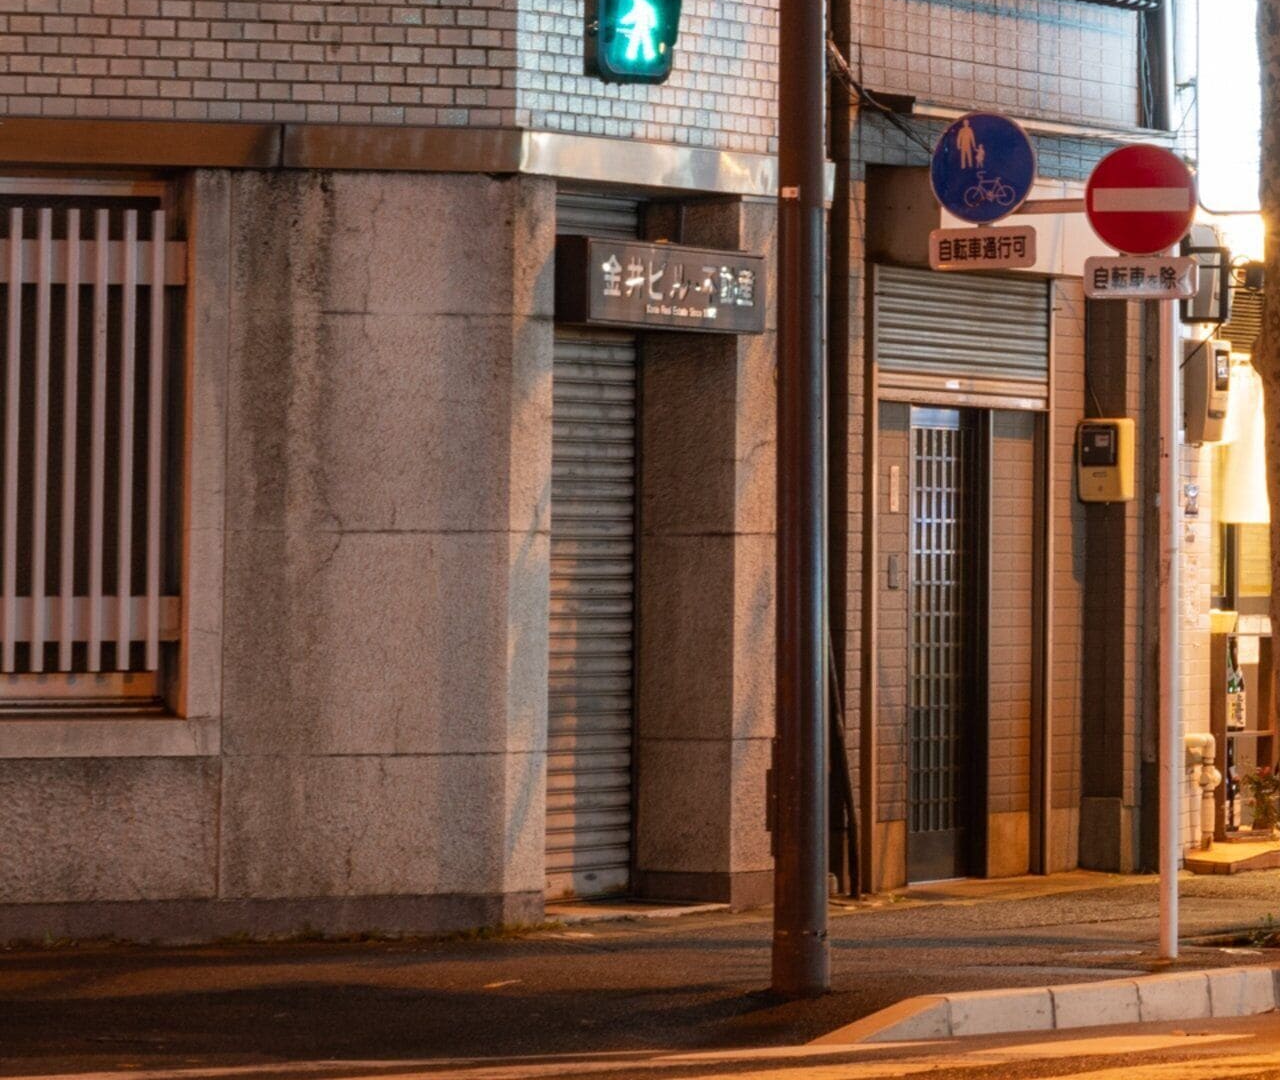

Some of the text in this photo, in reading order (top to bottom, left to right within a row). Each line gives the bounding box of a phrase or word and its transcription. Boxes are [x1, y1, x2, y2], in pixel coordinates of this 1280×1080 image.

[938, 234, 1028, 262] 自転車通行可
[1092, 265, 1192, 291] 自転車を除く
